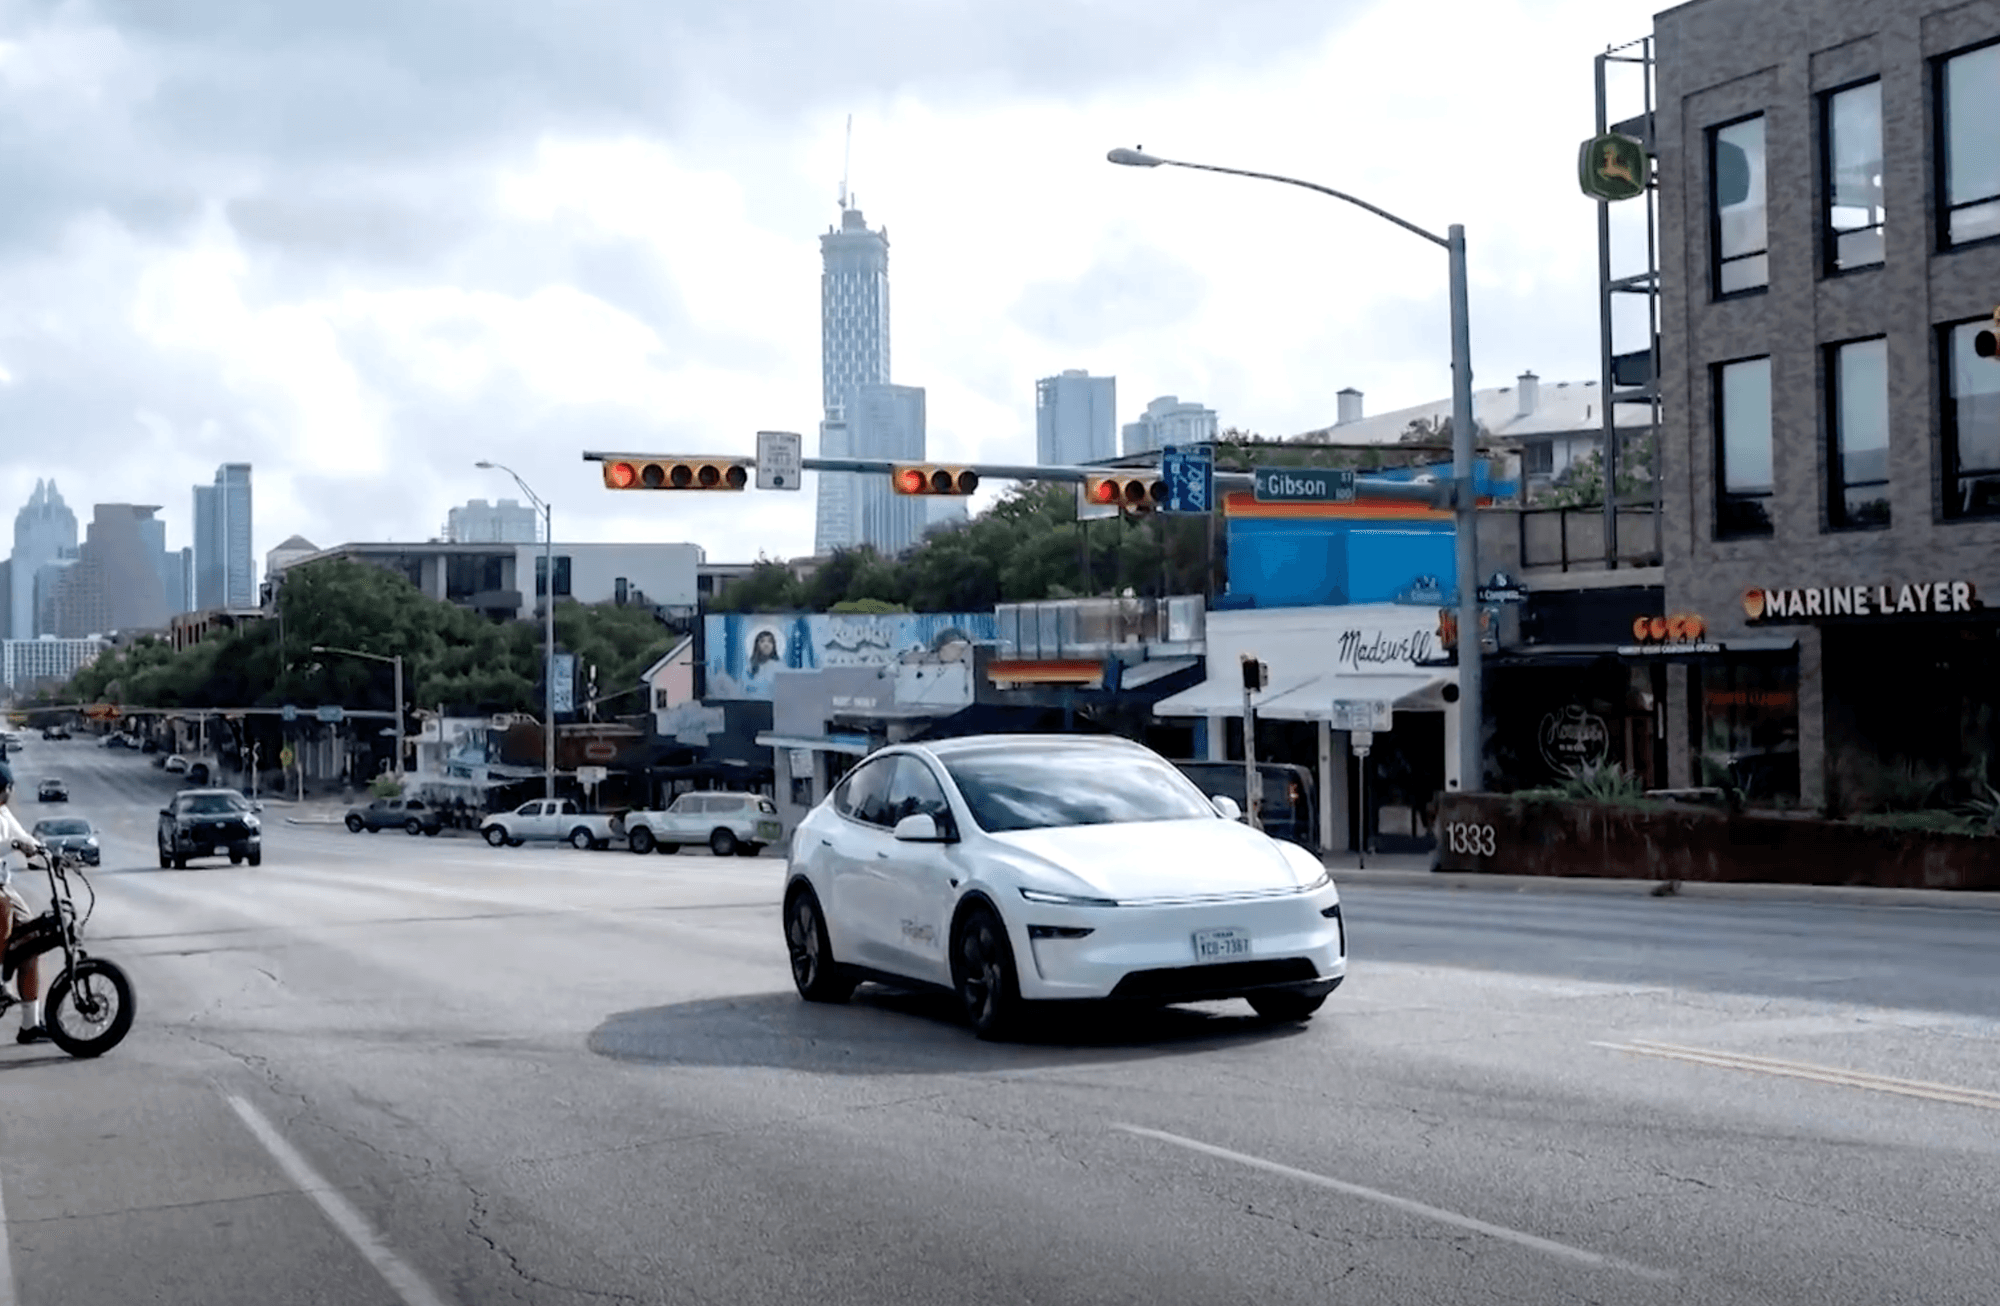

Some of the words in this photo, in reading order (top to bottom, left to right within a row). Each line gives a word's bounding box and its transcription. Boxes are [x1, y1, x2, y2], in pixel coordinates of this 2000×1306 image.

[1268, 474, 1326, 495] Gibson
[1765, 586, 1871, 617] MARINE
[1879, 581, 1971, 614] LAYER
[1338, 630, 1432, 671] Madewell
[1446, 822, 1496, 857] 1333
